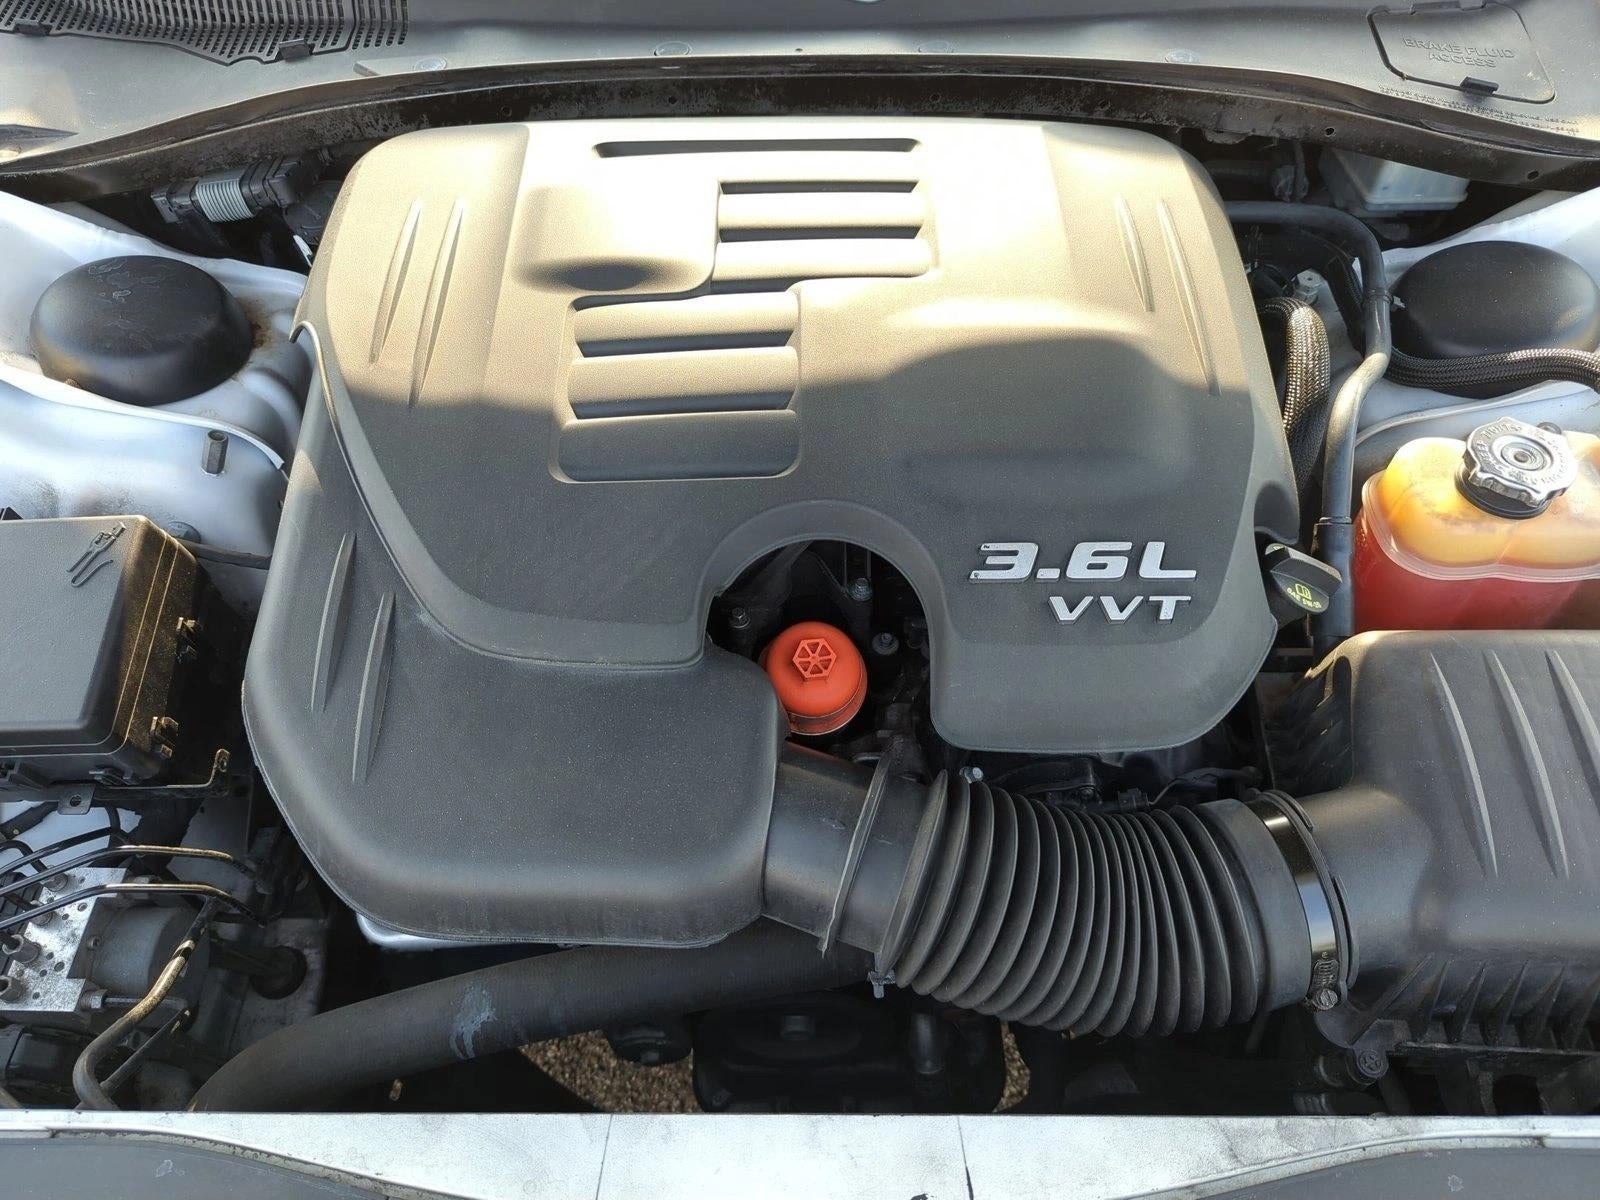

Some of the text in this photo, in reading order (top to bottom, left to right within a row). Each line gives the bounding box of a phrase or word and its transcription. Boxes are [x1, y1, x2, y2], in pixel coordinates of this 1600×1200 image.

[1402, 37, 1515, 58] BRAKE FLUID
[1428, 52, 1497, 68] ACCESS
[969, 541, 1197, 583] 3.6L
[1049, 595, 1191, 624] VVT
